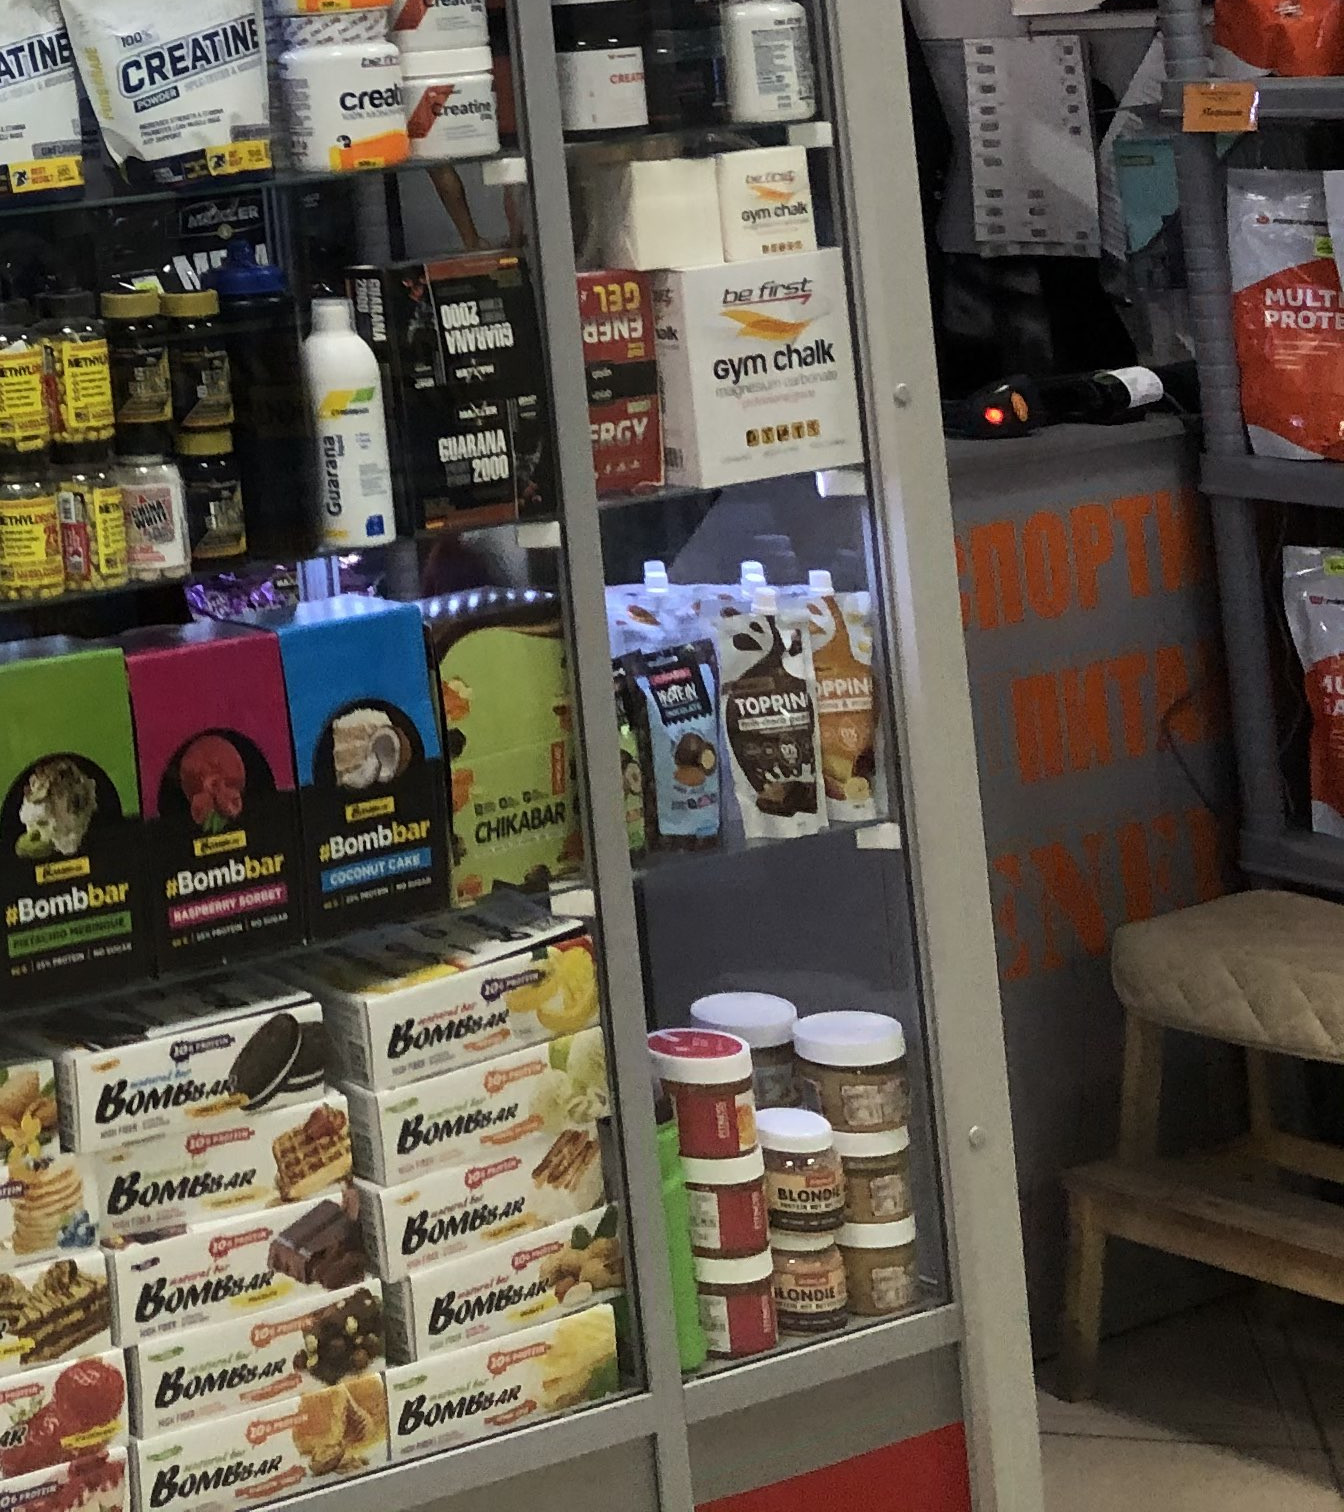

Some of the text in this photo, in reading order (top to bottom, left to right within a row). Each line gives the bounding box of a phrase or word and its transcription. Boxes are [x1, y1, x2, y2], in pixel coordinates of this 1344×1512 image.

[121, 19, 257, 94] CREATINE
[135, 89, 177, 110] POWDER
[433, 99, 492, 117] Creatine
[742, 201, 809, 223] Gym chalk
[441, 301, 479, 328] 2000
[593, 284, 640, 312] GEL
[723, 278, 813, 306] be first
[444, 322, 514, 355] GUARANA
[714, 339, 836, 384] Gym chalk
[439, 429, 509, 463] GUARANA
[326, 436, 344, 518] Guarana
[472, 457, 509, 484] 2000
[319, 818, 431, 862] #Bombbar
[474, 802, 566, 847] CHIKABAR
[166, 852, 284, 899] #Bombbar
[330, 854, 421, 886] COCONUT CAKE
[5, 882, 129, 927] #Bombbar
[174, 887, 283, 925] RASPBERRY SORBET
[387, 1007, 511, 1059] BOMBBAR
[94, 1073, 236, 1125] BOMBBAR
[396, 1102, 519, 1156] BOMBBAR
[106, 1168, 256, 1216] BOMBBAR
[401, 1195, 525, 1256] BOMBBAR
[134, 1268, 275, 1323] BOMBBAR
[428, 1277, 551, 1336] BOMBBAR
[155, 1355, 286, 1409] BOMBBAR
[398, 1384, 521, 1437] BOMBBAR
[150, 1453, 282, 1509] BOMBBAR
